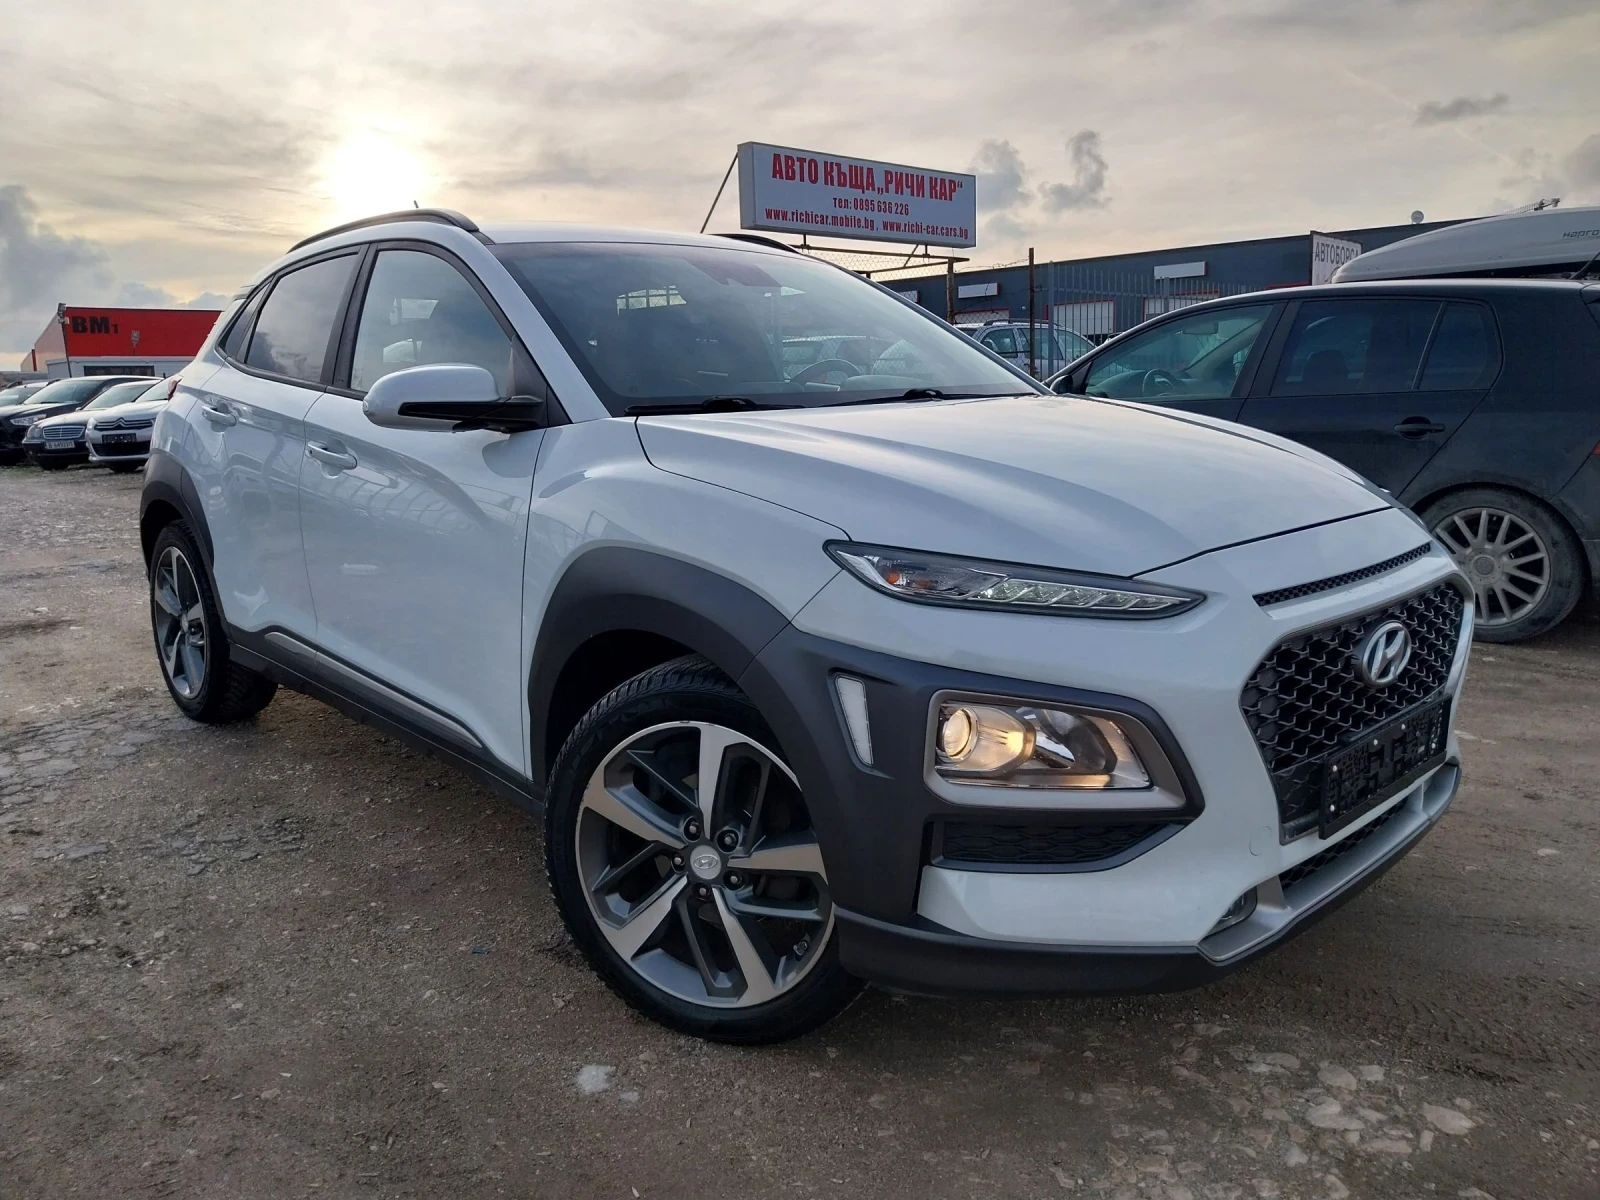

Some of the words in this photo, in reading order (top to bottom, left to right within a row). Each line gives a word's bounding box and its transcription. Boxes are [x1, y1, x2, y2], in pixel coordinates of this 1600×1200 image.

[771, 153, 819, 185] АВТО
[823, 160, 876, 194] КЪЩА
[833, 197, 852, 210] тел:
[853, 198, 875, 213] 0895
[877, 200, 893, 214] 636
[894, 202, 909, 216] 226
[882, 219, 968, 240] www.richi-car.cars.bg
